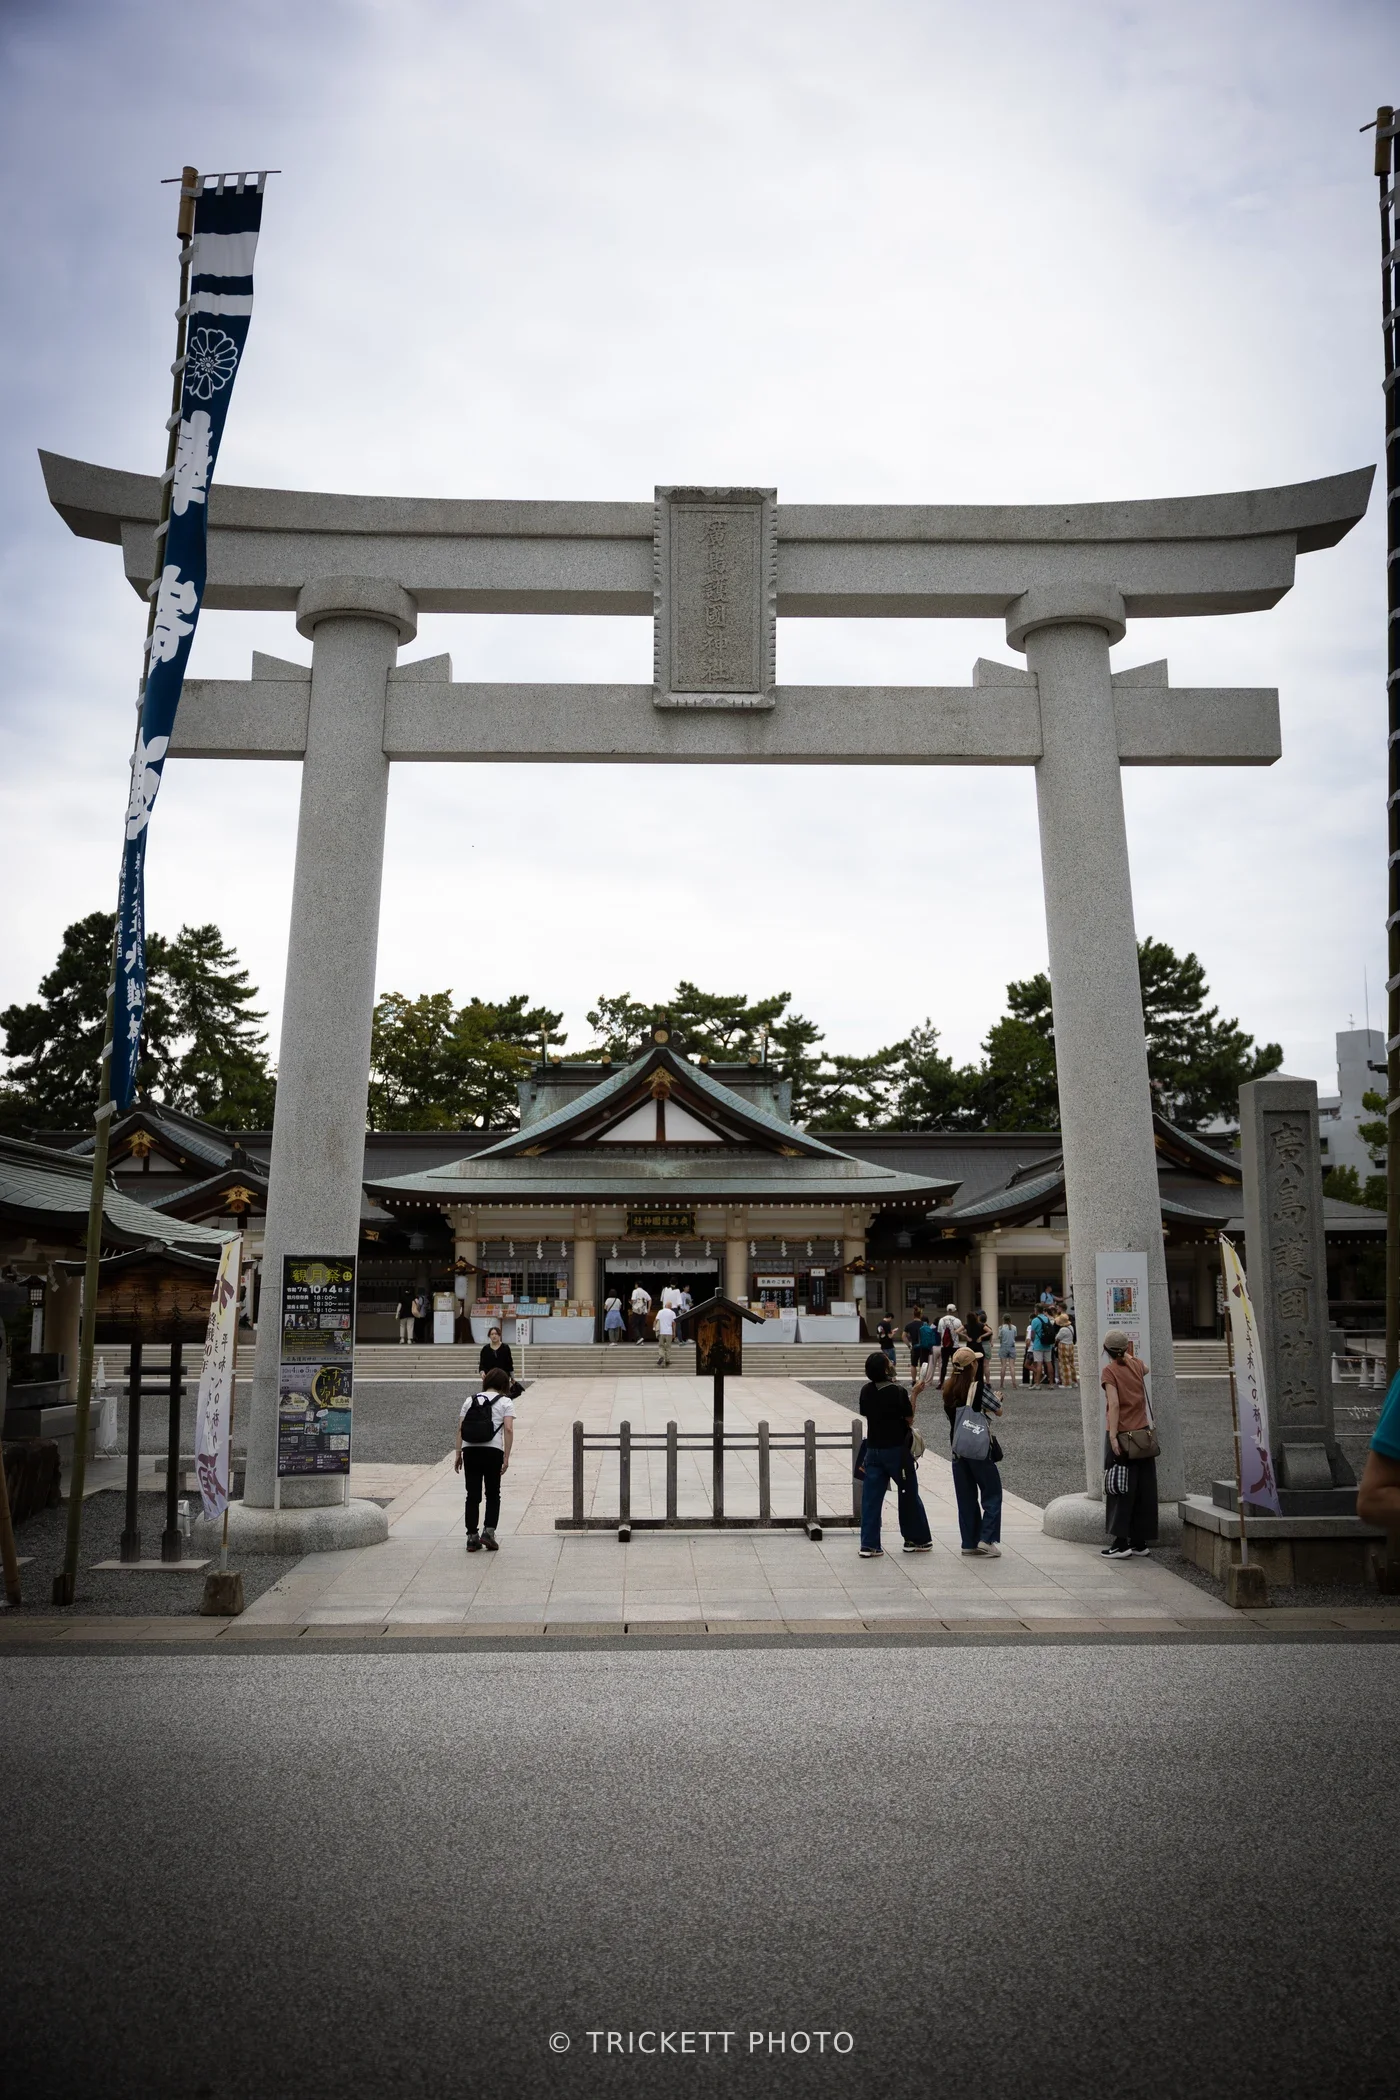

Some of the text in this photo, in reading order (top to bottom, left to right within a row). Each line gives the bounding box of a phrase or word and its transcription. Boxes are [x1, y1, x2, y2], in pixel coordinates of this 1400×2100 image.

[293, 1269, 340, 1283] 観月祭
[1269, 1121, 1319, 1412] 廣島護國神社
[332, 1370, 342, 1396] ナイト
